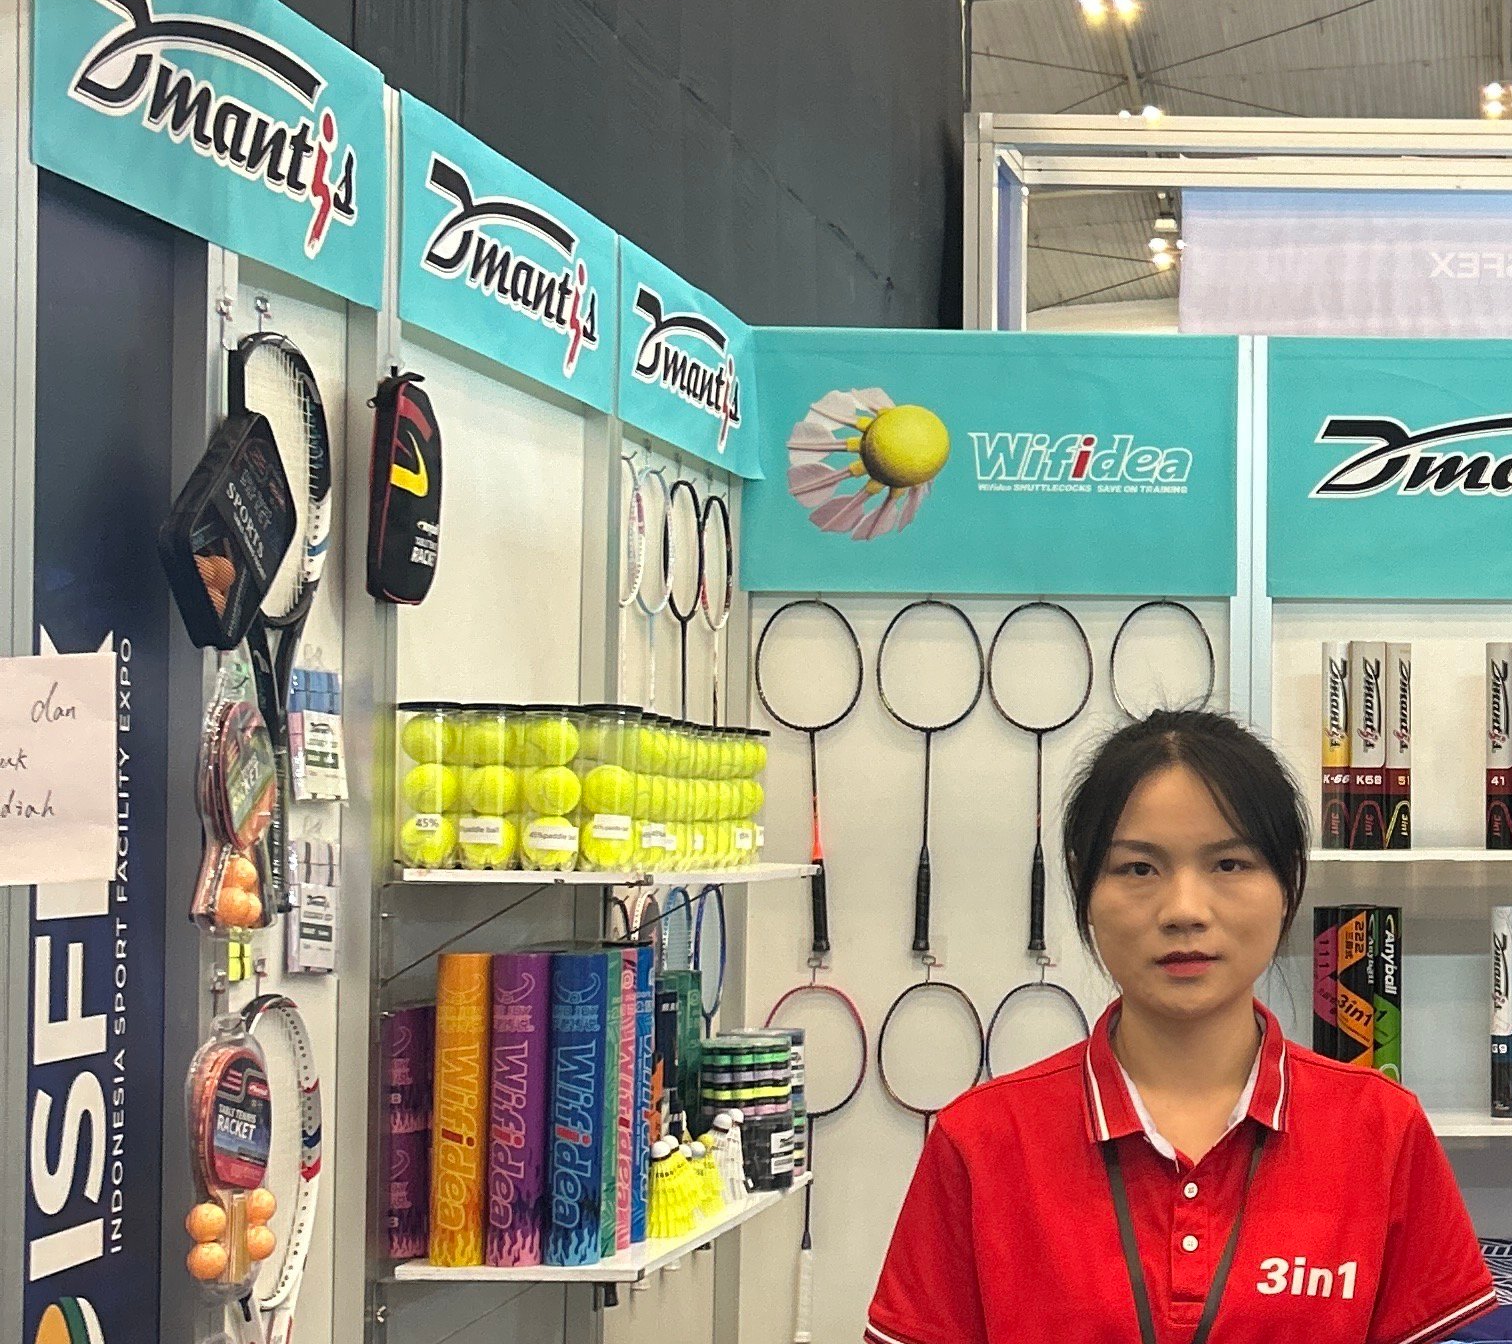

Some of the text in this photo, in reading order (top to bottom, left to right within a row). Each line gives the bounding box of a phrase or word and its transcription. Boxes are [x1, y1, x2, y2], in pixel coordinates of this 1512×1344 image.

[967, 432, 1193, 484] Wifidea
[1013, 484, 1091, 493] SHUTTLECOCKS
[1139, 486, 1188, 494] TRAINING
[30, 624, 115, 1282] ISF
[111, 637, 132, 1254] INDONESIA SPORT FACILITY EXPO
[1381, 928, 1398, 996] Anyball
[1338, 993, 1373, 1027] 3in1
[217, 1114, 257, 1140] RACKET
[437, 1041, 483, 1230] Wifidea
[488, 1040, 528, 1229] Wifidea
[548, 1040, 597, 1229] Wifidea
[1256, 1256, 1357, 1299] 3in1
